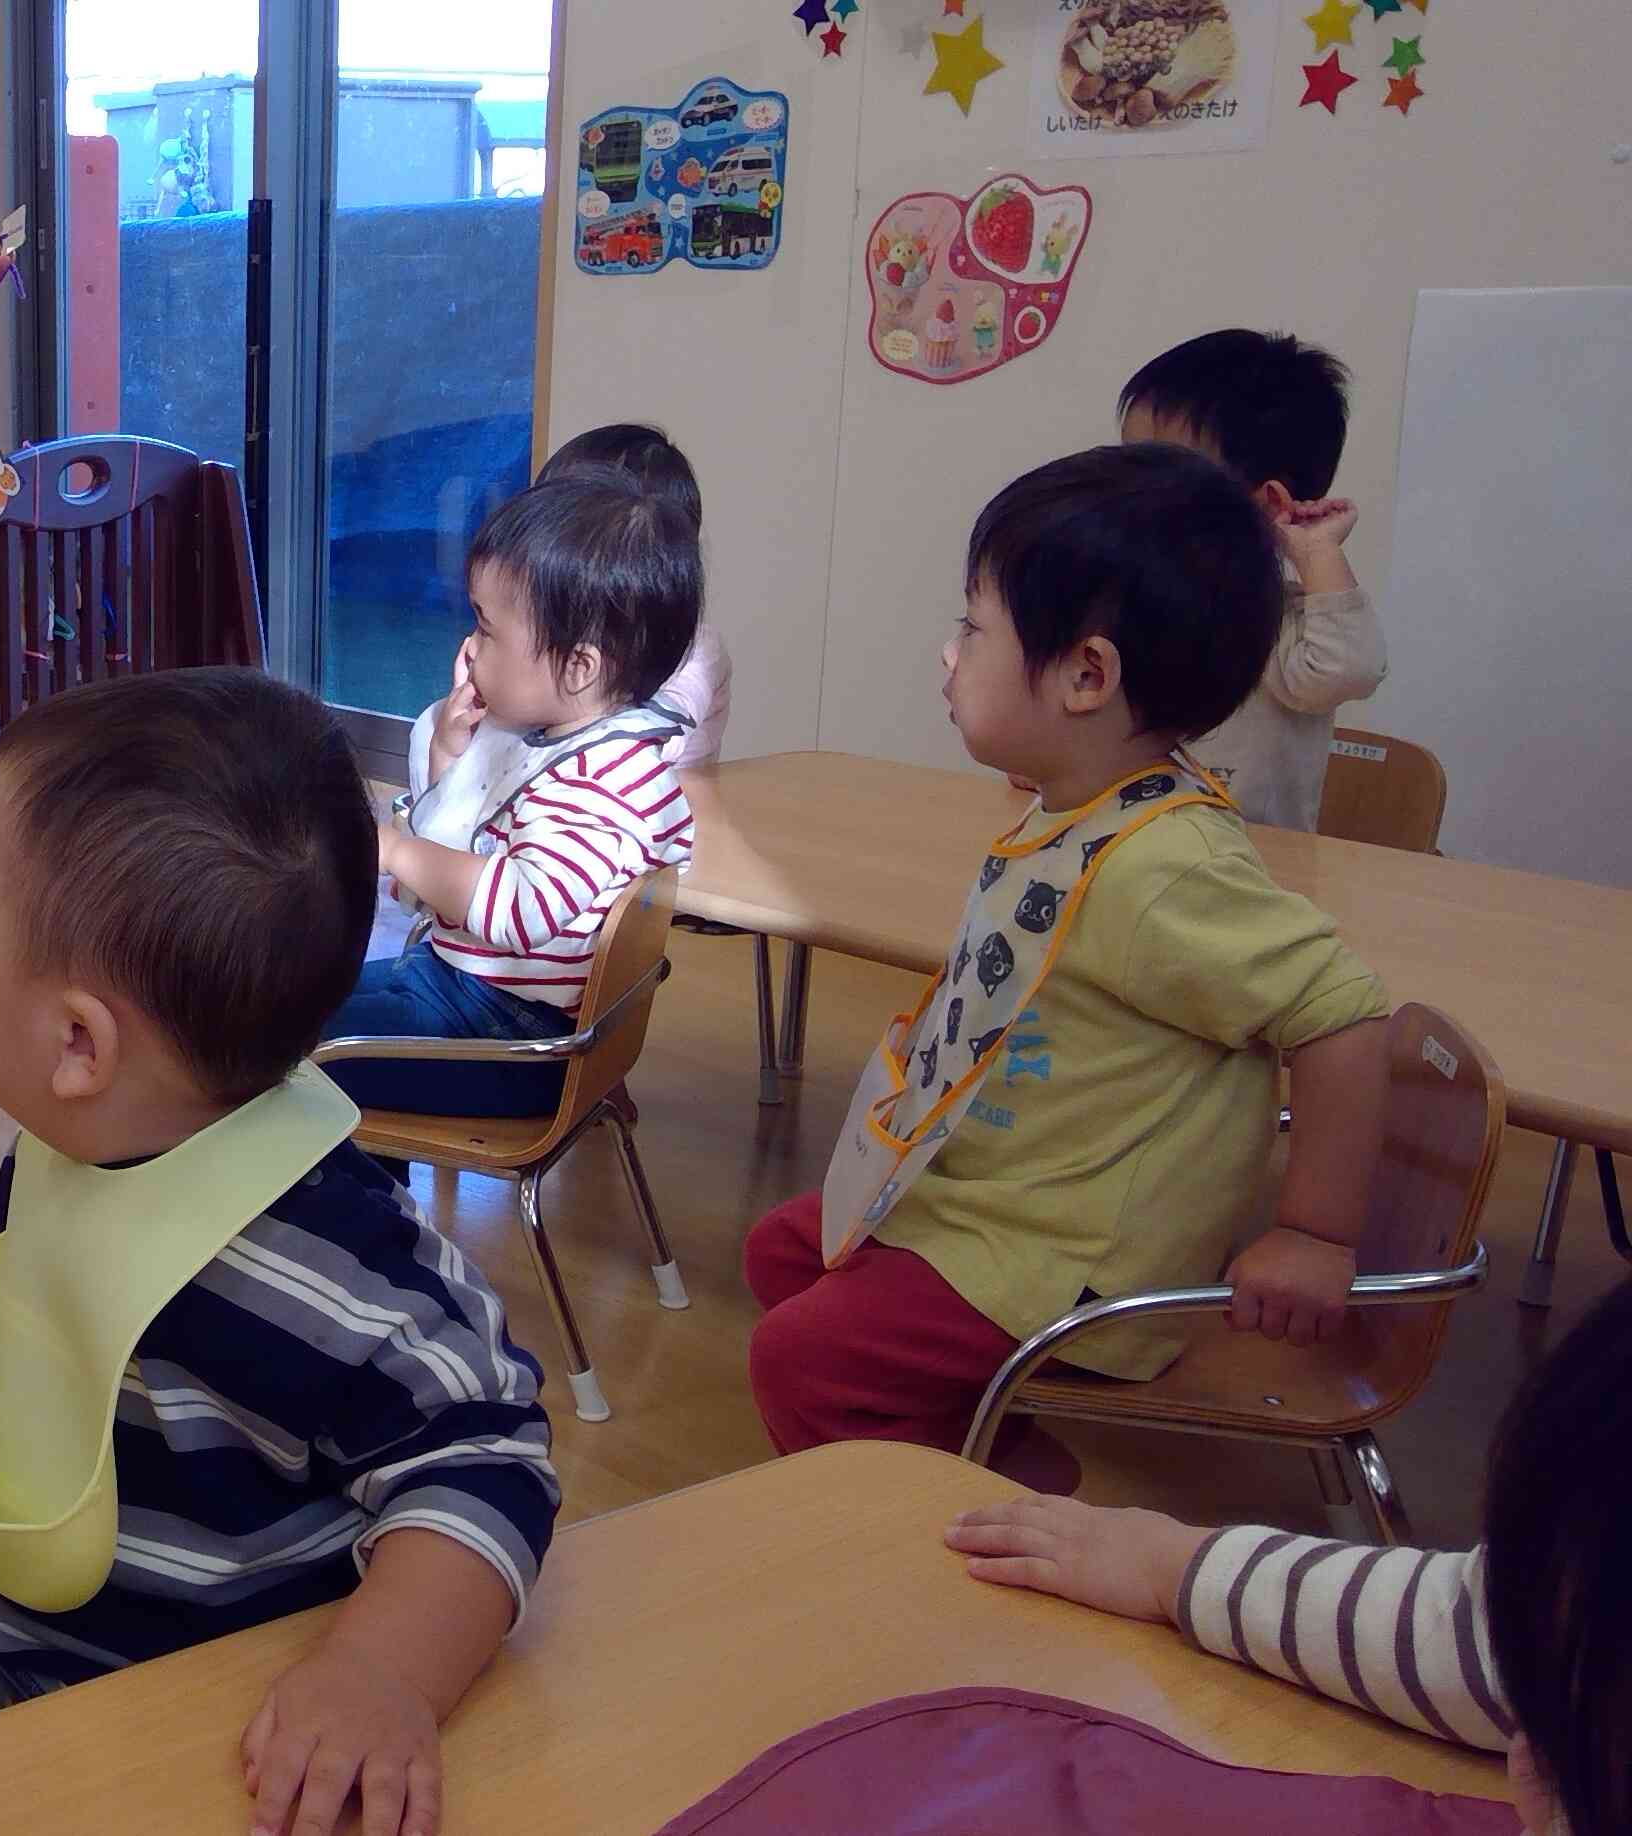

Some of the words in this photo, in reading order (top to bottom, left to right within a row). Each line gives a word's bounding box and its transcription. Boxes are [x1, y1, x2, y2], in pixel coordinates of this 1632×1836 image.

[1047, 115, 1103, 133] しいたけ
[1202, 767, 1239, 779] EY
